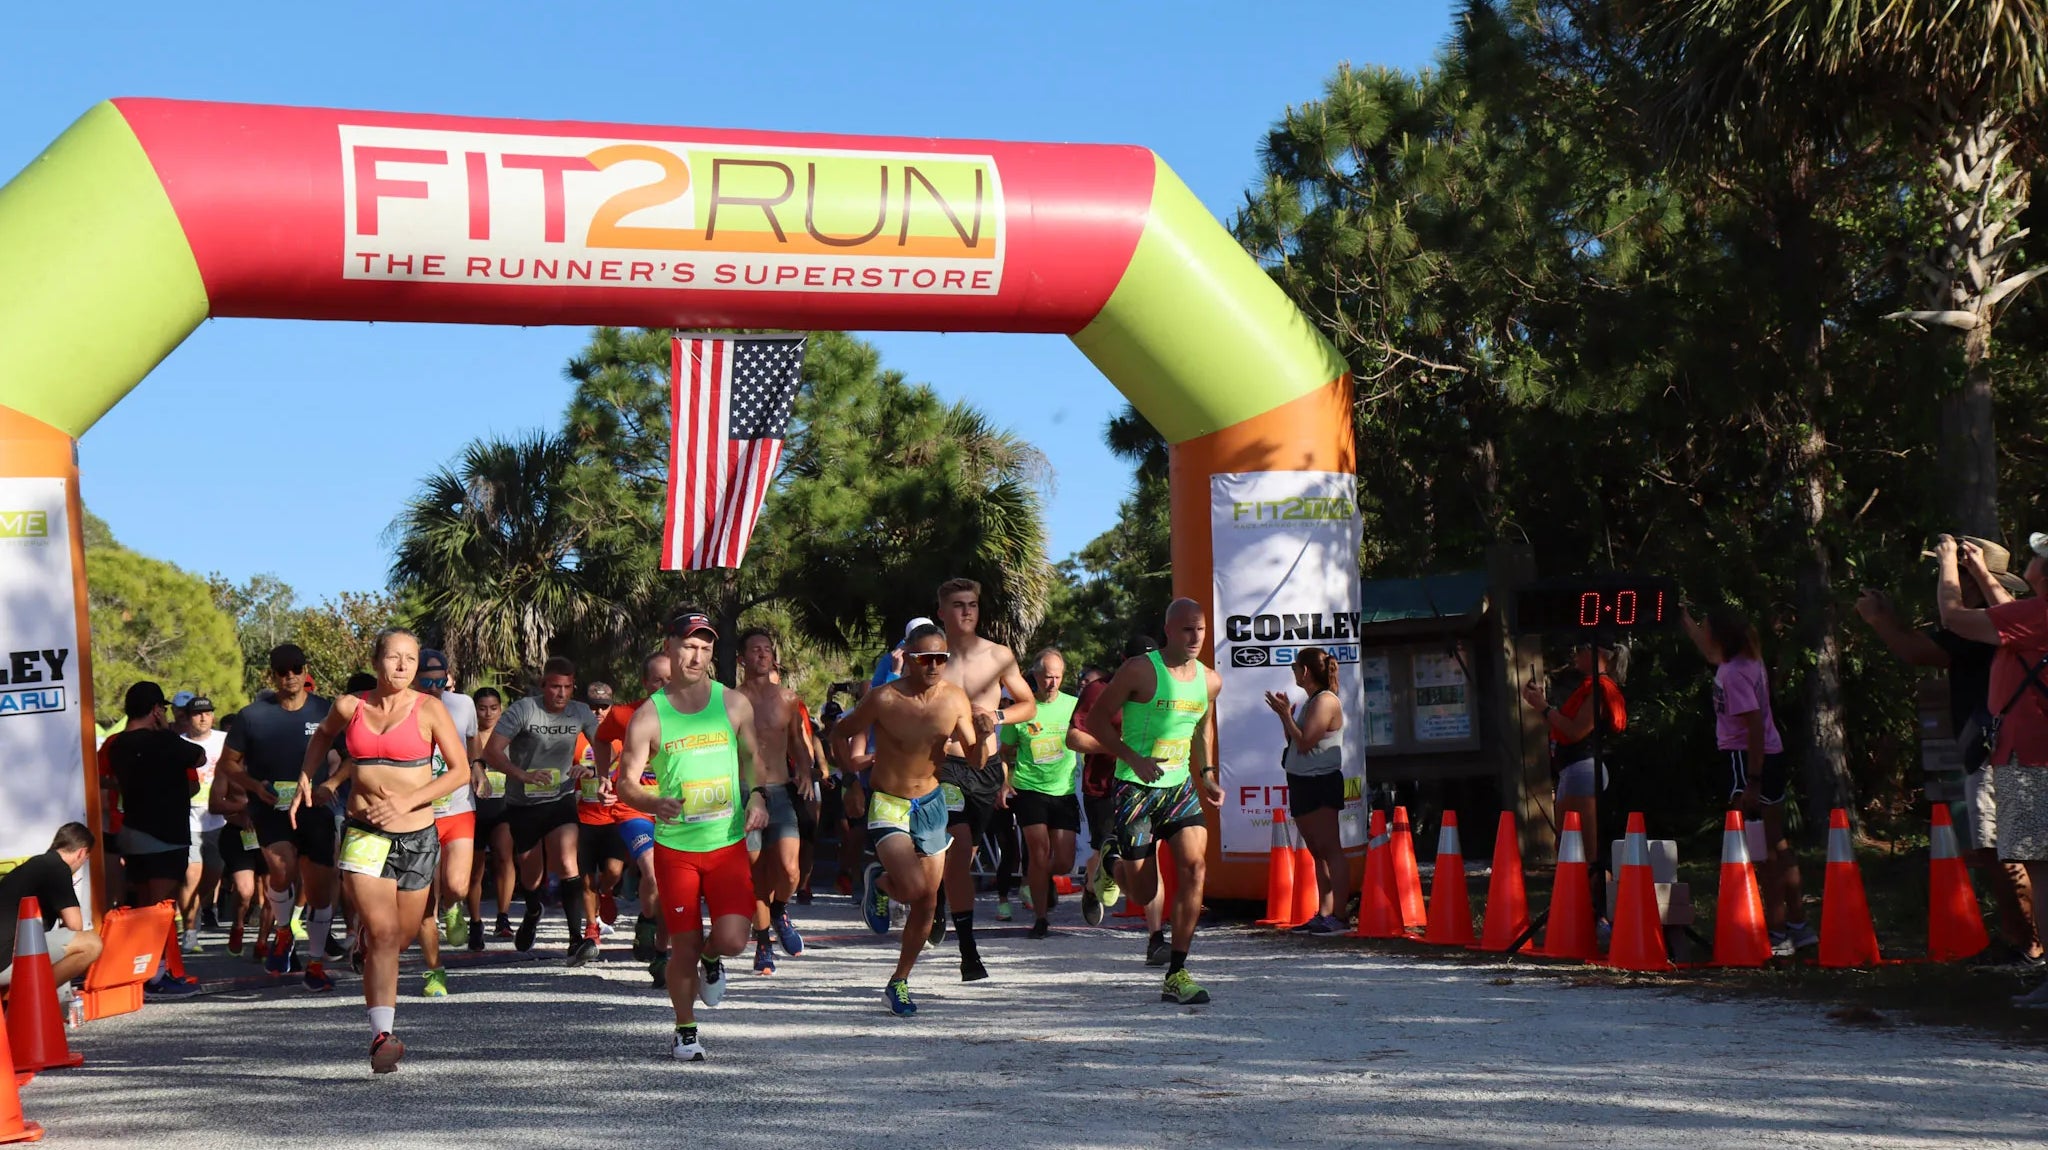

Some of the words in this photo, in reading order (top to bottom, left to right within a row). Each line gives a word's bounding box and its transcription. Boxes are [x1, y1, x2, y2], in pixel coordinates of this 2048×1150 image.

[353, 143, 988, 252] FIT2RUN
[356, 252, 446, 276] THE
[467, 256, 695, 283] RUNNER'S
[714, 263, 993, 289] SUPERSTORE
[1226, 612, 1360, 642] CONLEY
[529, 724, 577, 735] ROGUE
[1160, 744, 1185, 760] 704
[689, 784, 726, 806] 700
